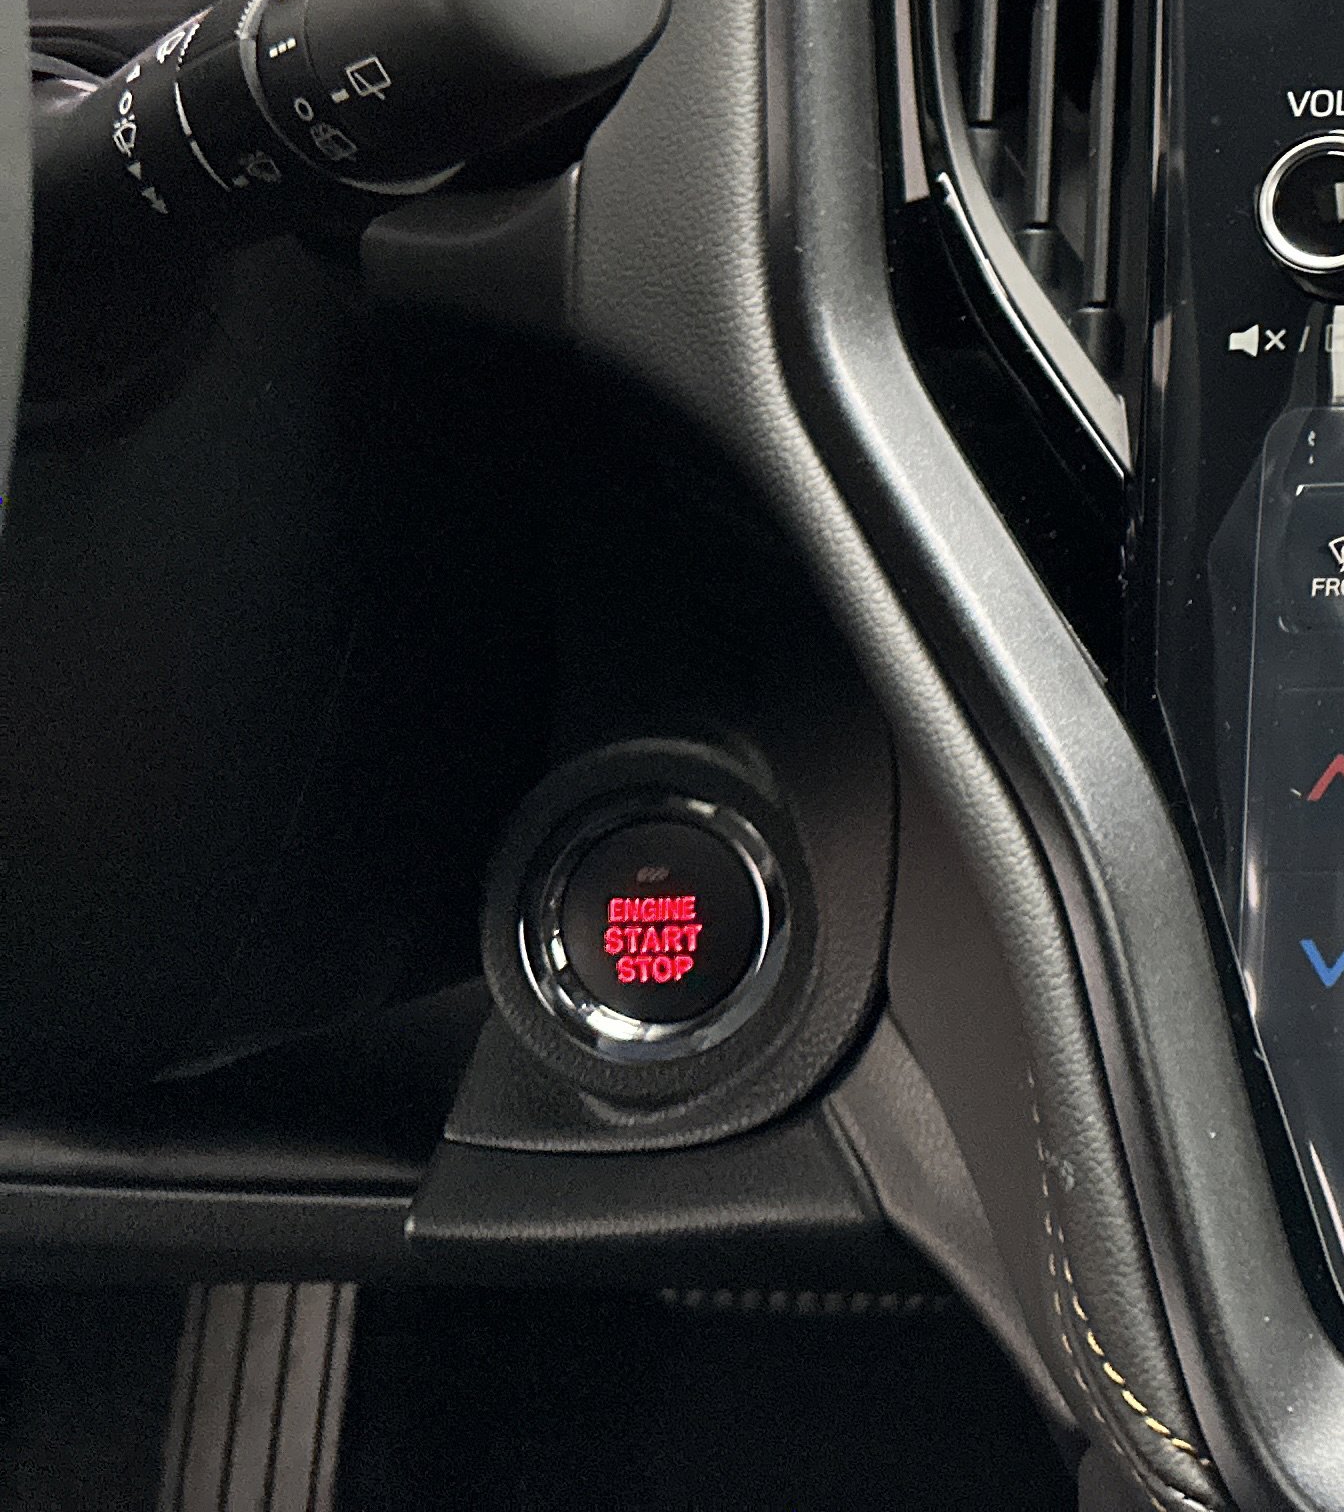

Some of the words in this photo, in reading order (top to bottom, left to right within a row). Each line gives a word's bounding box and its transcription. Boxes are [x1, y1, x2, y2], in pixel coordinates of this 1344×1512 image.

[607, 896, 697, 922] ENGINE
[604, 924, 703, 954] START
[616, 955, 694, 983] STOP
